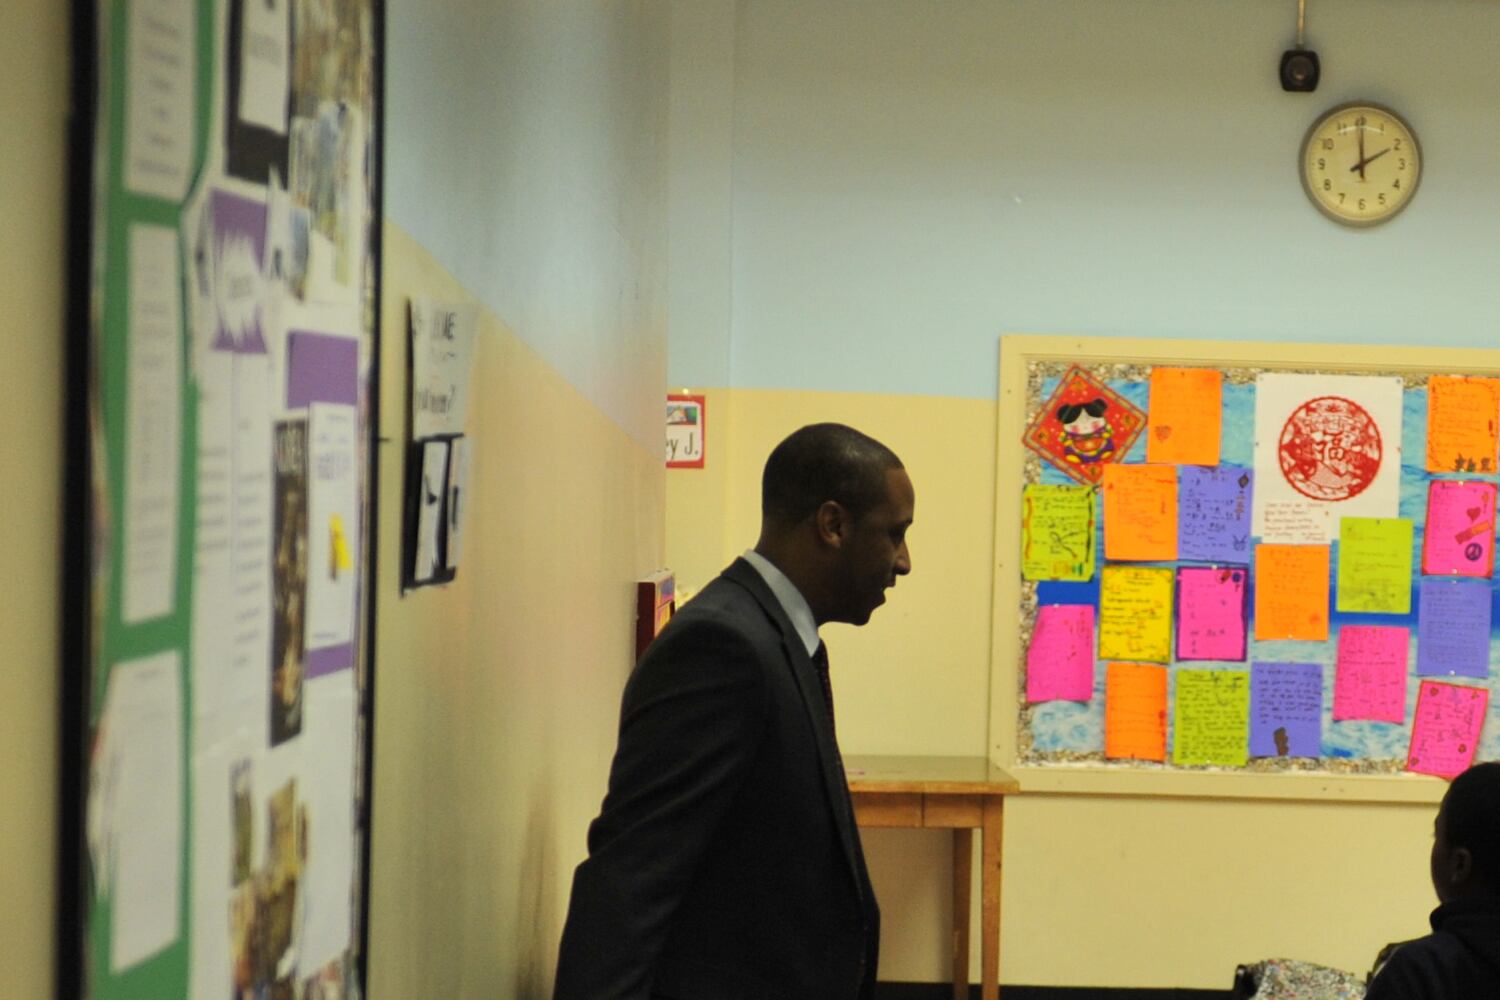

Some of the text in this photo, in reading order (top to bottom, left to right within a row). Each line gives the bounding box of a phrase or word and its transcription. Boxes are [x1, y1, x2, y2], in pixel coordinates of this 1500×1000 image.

[1393, 138, 1401, 151] 2
[1317, 158, 1326, 170] 9
[1397, 158, 1406, 170] 3
[1323, 179, 1332, 191] 8
[1392, 179, 1400, 190] 4
[1338, 193, 1346, 204] 7
[1358, 198, 1366, 210] 6
[1378, 193, 1386, 204] 5
[665, 432, 699, 461] y J.
